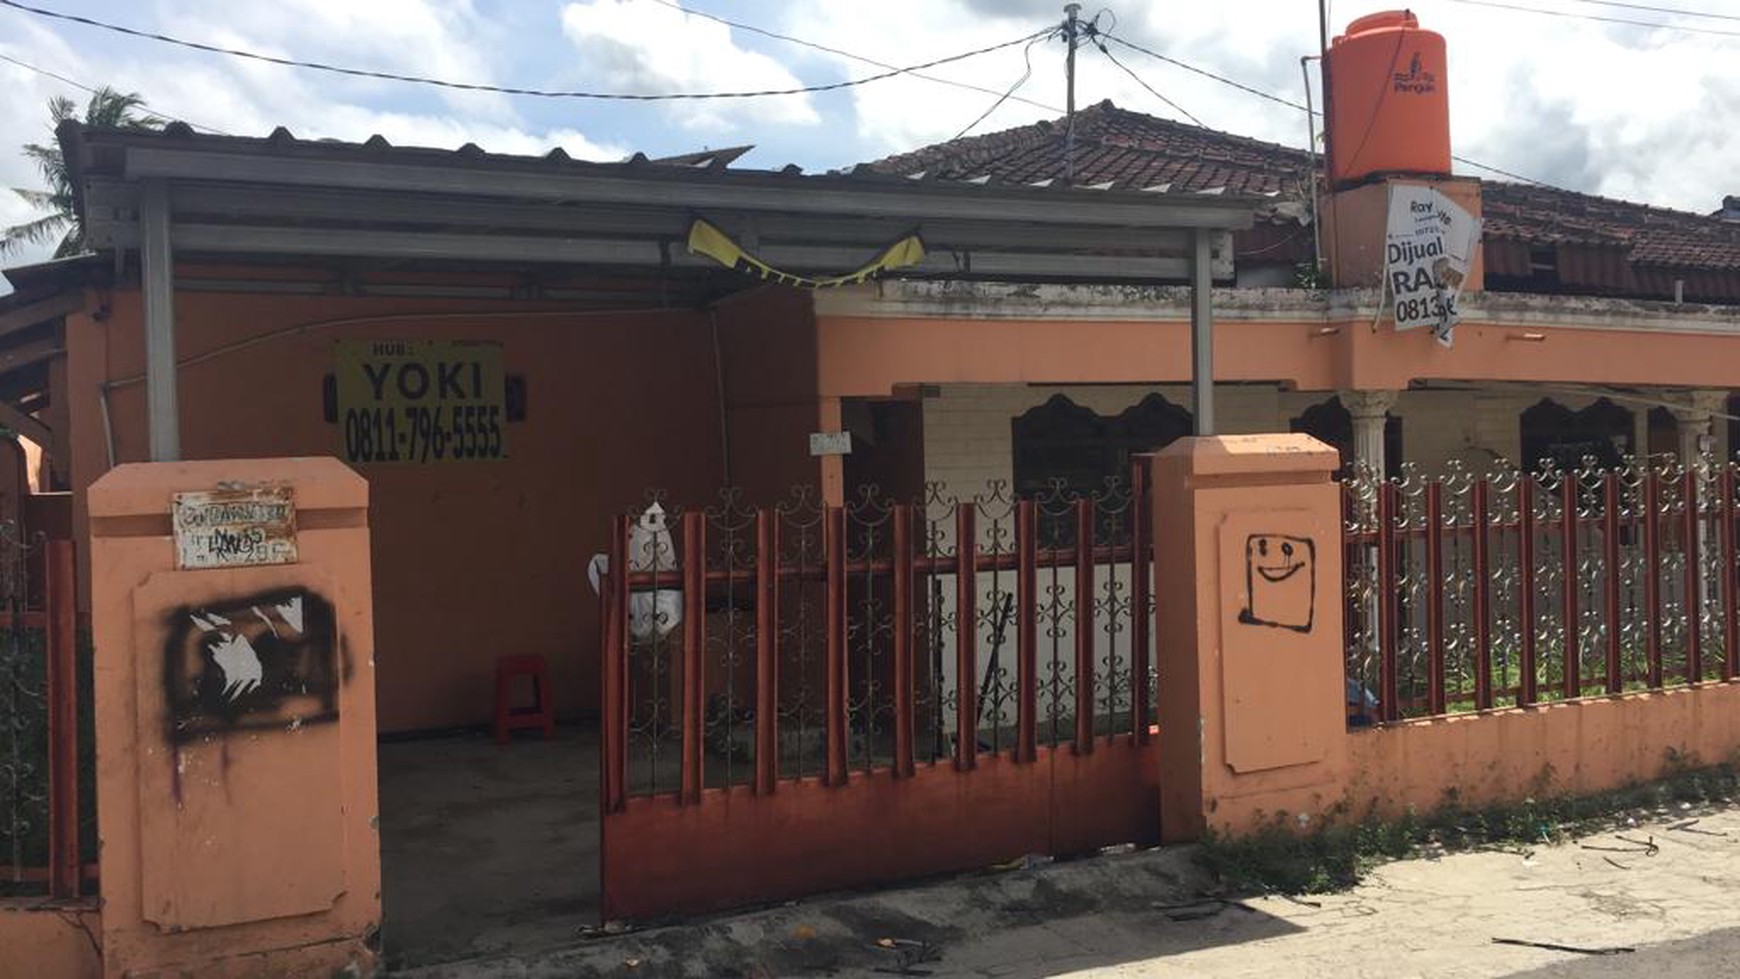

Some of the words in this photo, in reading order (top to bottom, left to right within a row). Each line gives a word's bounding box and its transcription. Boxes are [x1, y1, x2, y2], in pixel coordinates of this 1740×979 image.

[1410, 201, 1434, 213] Ray
[1388, 237, 1443, 265] Dijual
[363, 362, 482, 400] YOKI
